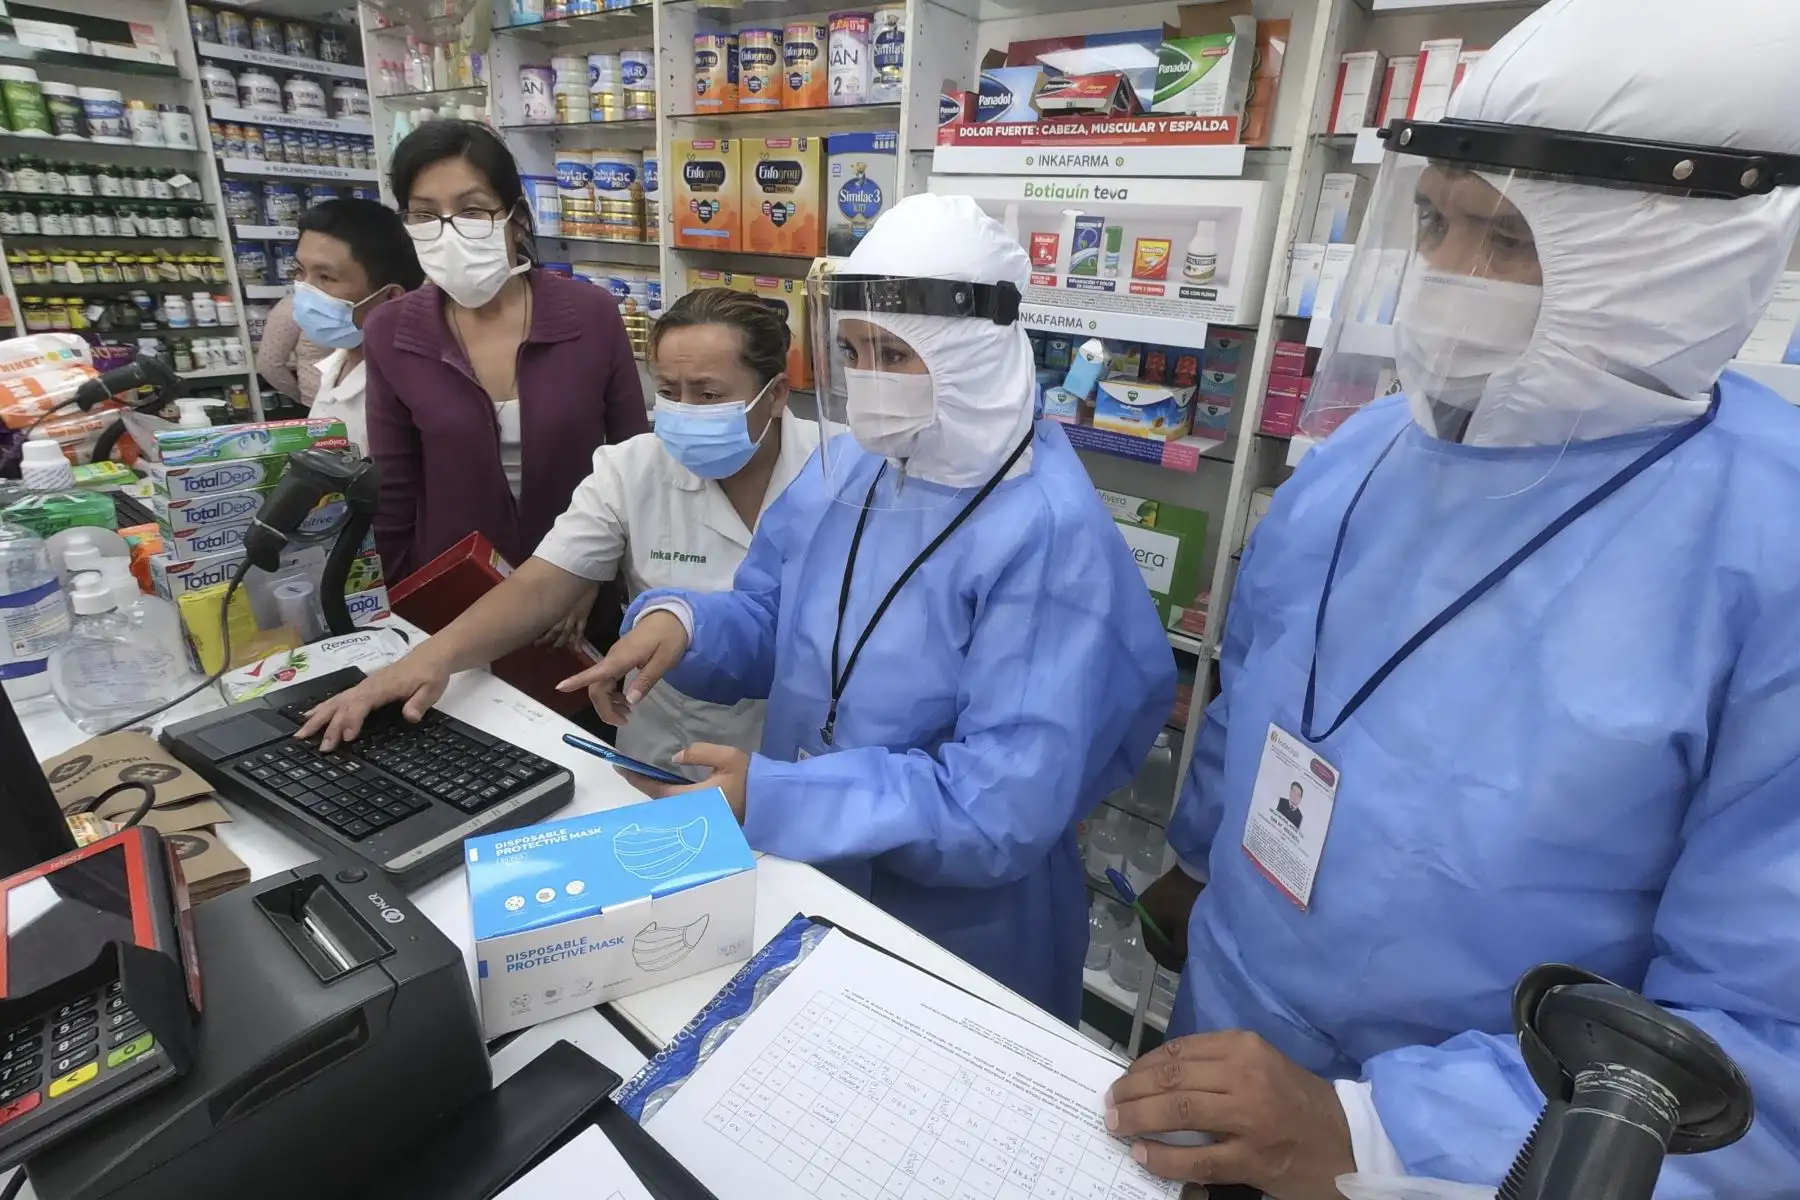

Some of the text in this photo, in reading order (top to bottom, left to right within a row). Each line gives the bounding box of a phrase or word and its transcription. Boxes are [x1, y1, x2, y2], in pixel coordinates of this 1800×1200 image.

[1159, 61, 1190, 74] Panadol
[833, 75, 842, 96] 2
[978, 93, 1012, 107] Panadol
[524, 103, 531, 118] 2
[960, 125, 993, 137] DOLOR
[1041, 123, 1089, 136] CABEZA,
[1091, 121, 1156, 134] MUSCULAR
[1159, 121, 1168, 133] Y
[1169, 119, 1230, 132] ESPALDA
[1038, 154, 1109, 168] INKAFARMA
[686, 165, 723, 182] Enfagrow
[758, 164, 801, 183] Enfagrow
[839, 189, 881, 204] Similac 3
[1024, 182, 1128, 200] Botiquín teva
[1019, 311, 1084, 330] NKAFARMA
[650, 549, 707, 564] Inka Farma
[320, 634, 371, 652] Rexona
[494, 828, 568, 850] DISPOSABLE
[495, 826, 603, 857] PROTECTIVE MASK
[368, 892, 390, 910] NCR
[505, 936, 588, 963] DISPOSABLE
[506, 935, 625, 973] PROTECTIVE MASK
